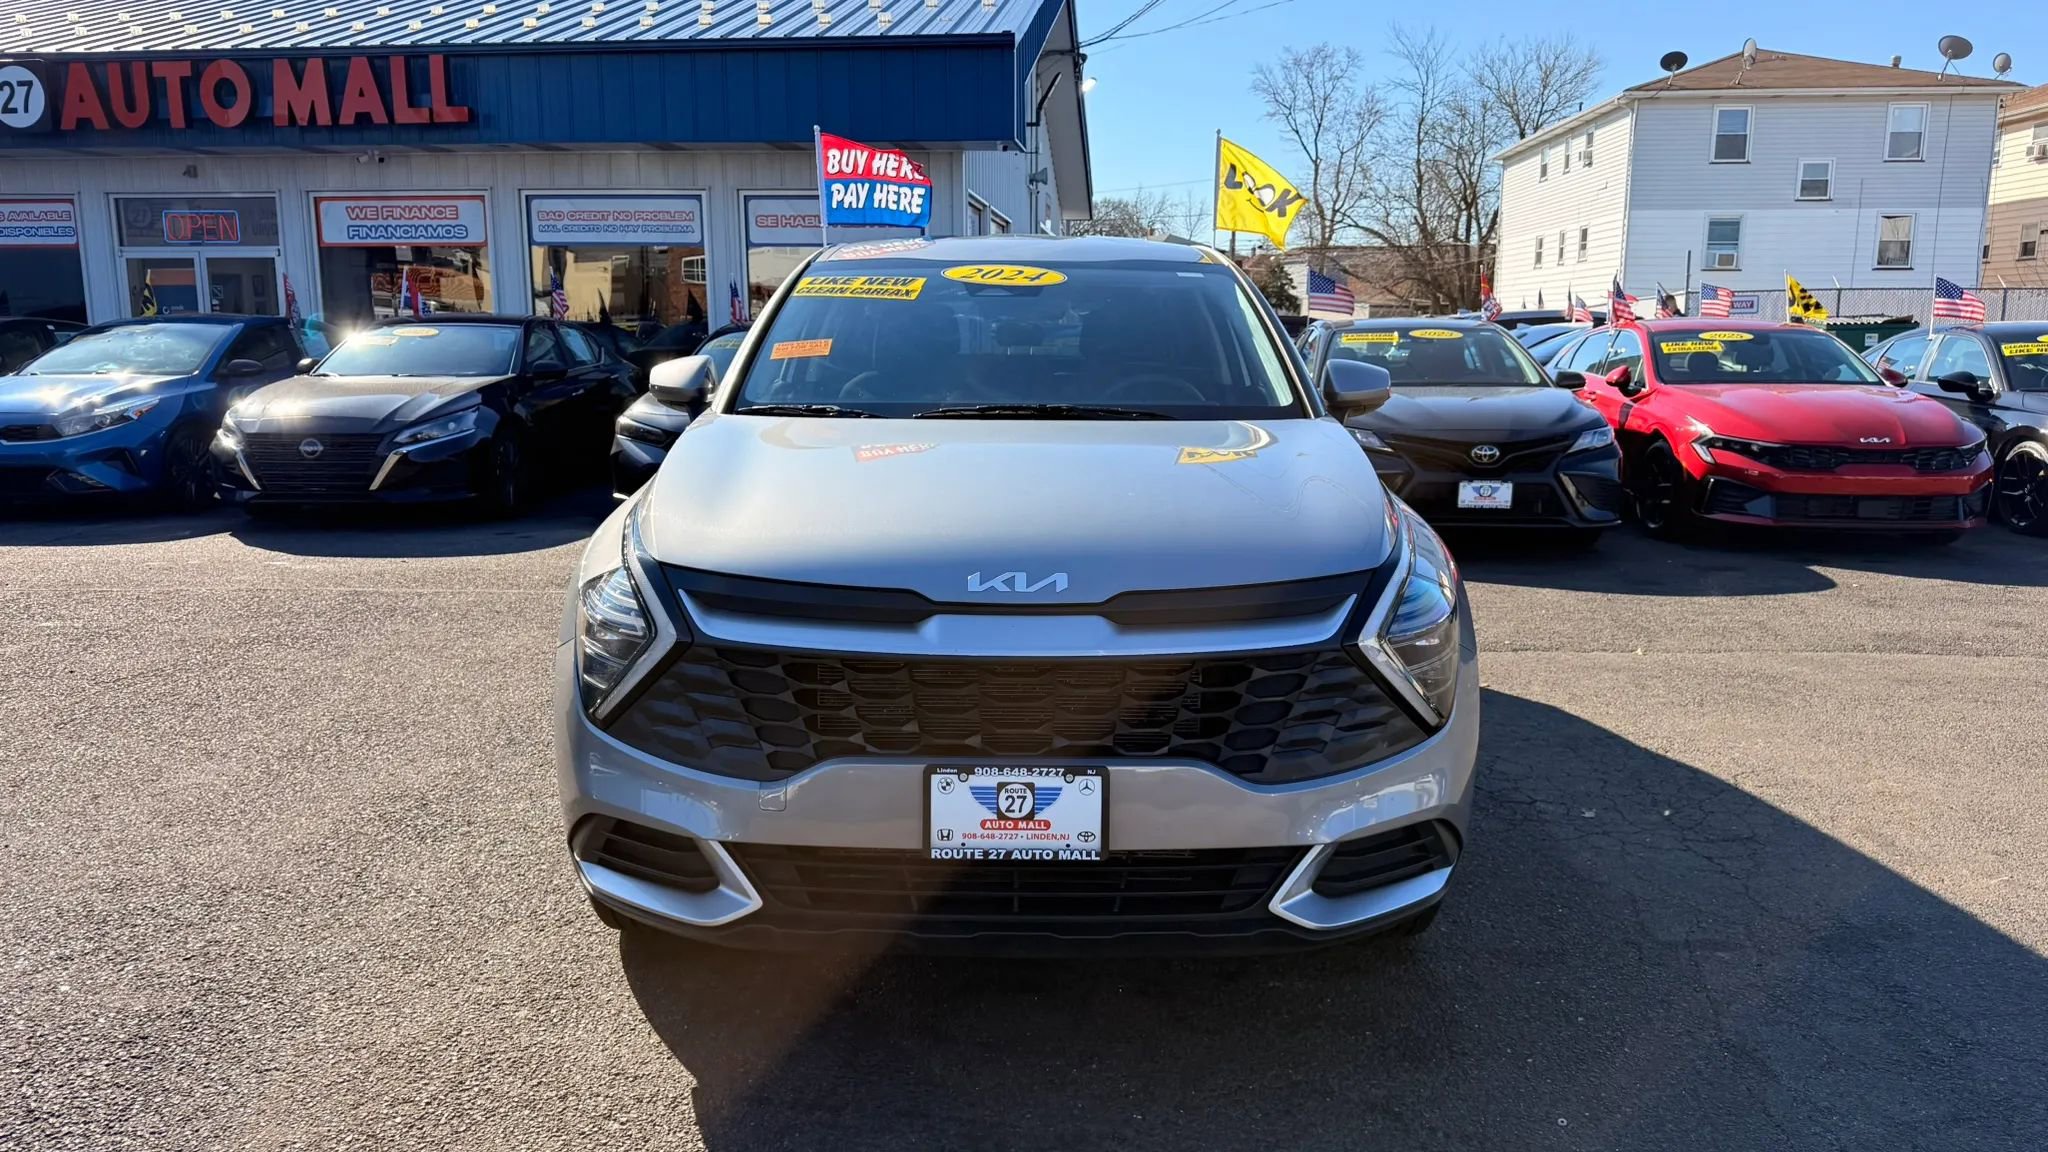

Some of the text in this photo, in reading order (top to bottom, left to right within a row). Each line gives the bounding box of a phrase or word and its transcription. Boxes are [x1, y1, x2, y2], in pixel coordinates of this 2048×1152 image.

[0, 80, 33, 114] 27
[60, 54, 469, 130] AUTO MALL
[827, 148, 869, 175] BUY
[830, 182, 926, 214] PAY HERE
[7, 210, 71, 221] AVAILABLE
[346, 205, 458, 220] WE FINANCE
[537, 210, 694, 222] BAD CREDIT NO PROBLEM
[166, 214, 238, 240] OPEN
[755, 214, 778, 228] SE
[347, 224, 468, 240] FINANCIAMOS
[538, 224, 695, 233] MAL CREDITO NO HAY PROBLEMA
[959, 268, 1049, 281] 2024
[806, 277, 917, 287] LIKE NEW
[795, 287, 918, 298] CLEAN CARFAX
[967, 571, 1069, 593] KIA
[974, 767, 1065, 777] 908-648-2727
[1004, 795, 1028, 813] 27
[984, 821, 1048, 830] AUTO MALL
[931, 849, 1101, 861] ROUTE 27 AUTO MALL
